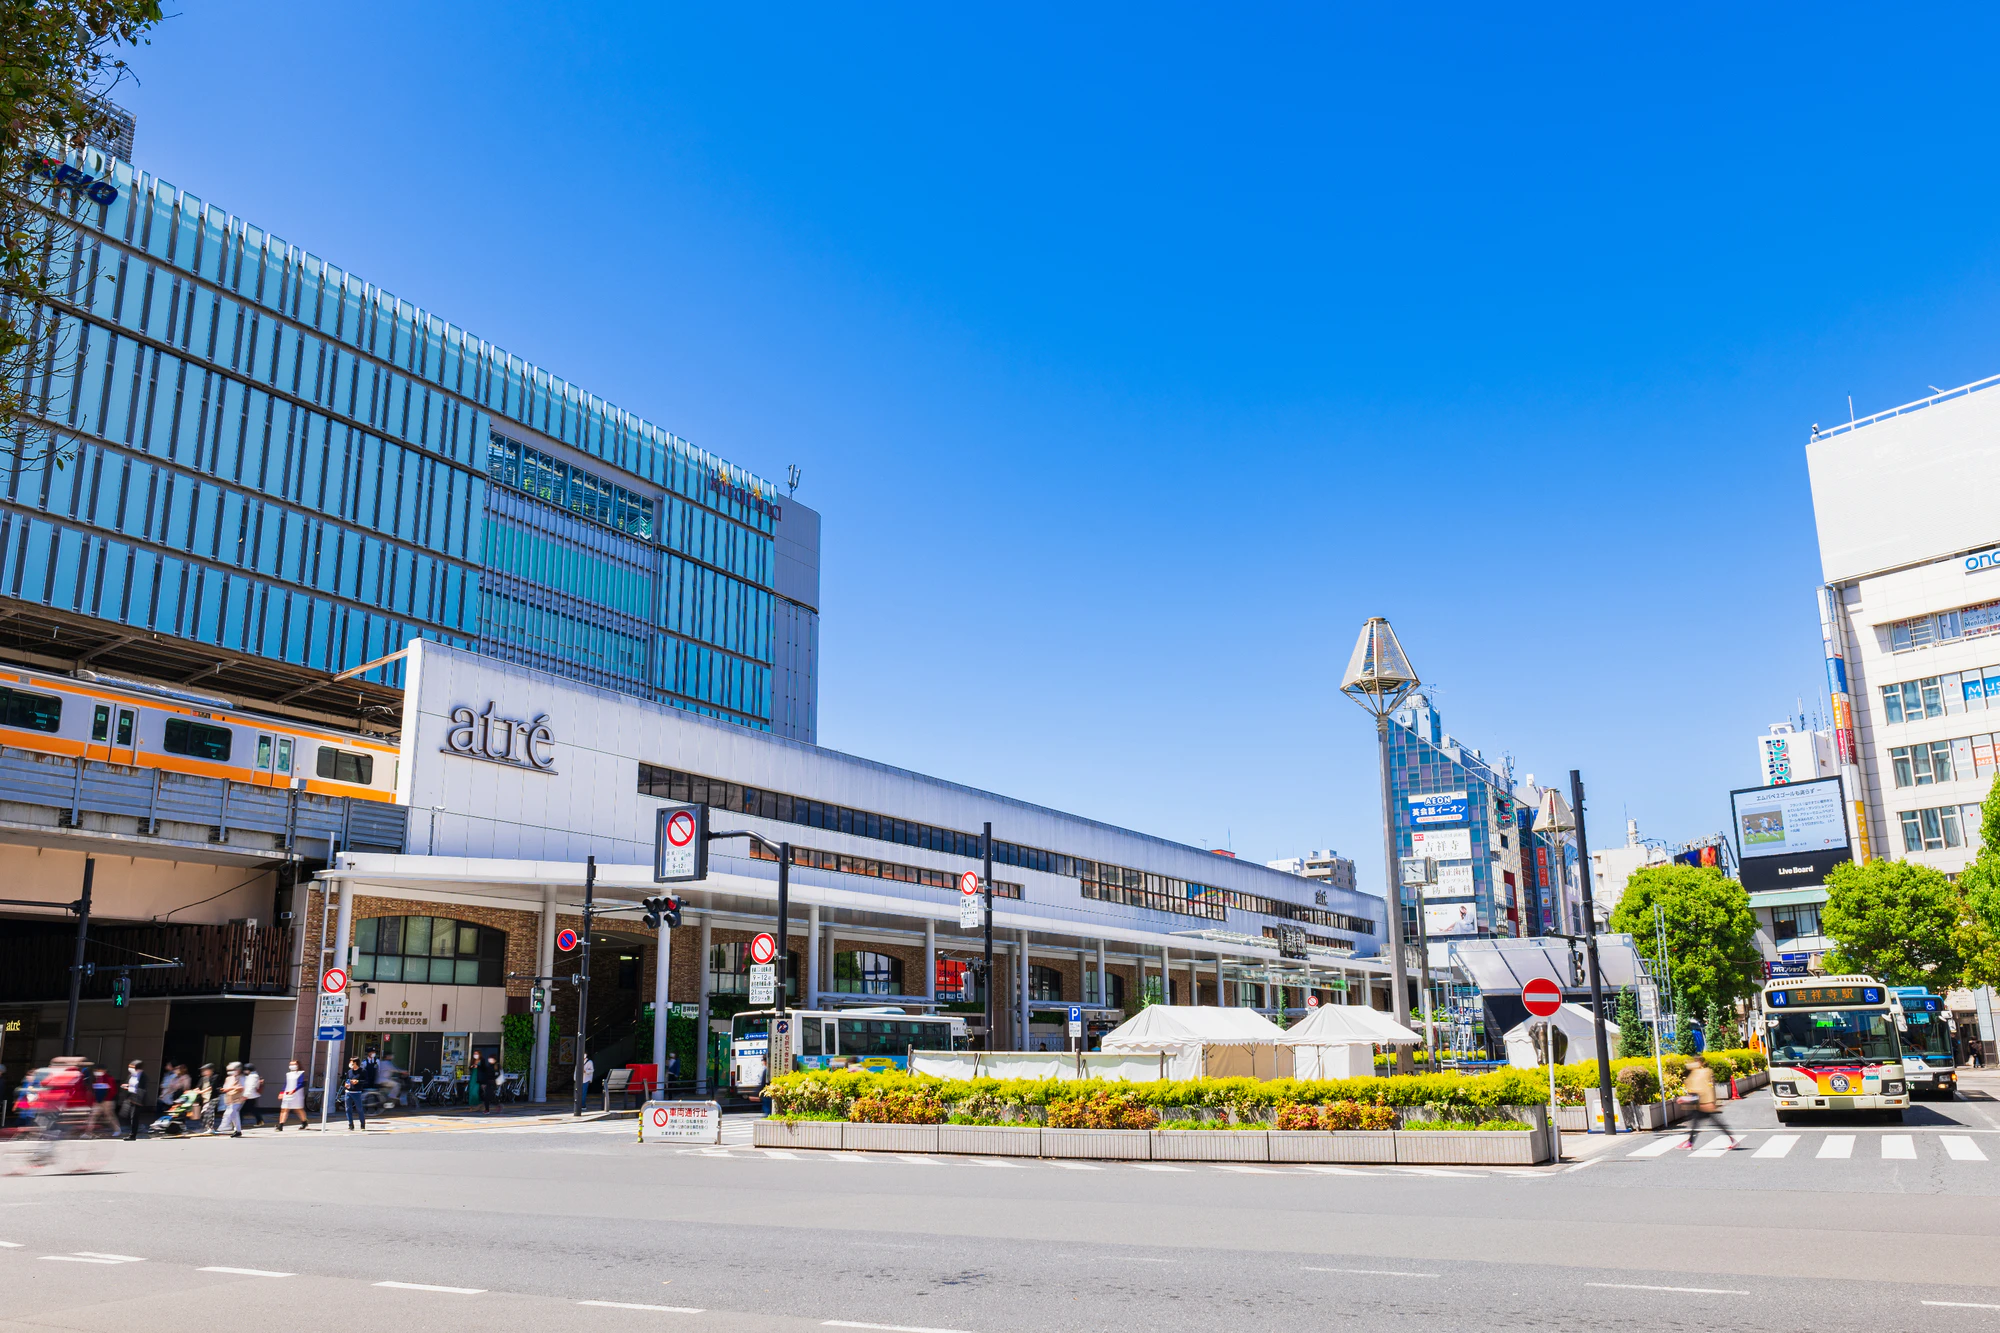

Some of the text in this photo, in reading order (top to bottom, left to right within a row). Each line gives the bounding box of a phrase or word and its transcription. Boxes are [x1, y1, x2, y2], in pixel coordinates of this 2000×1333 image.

[447, 700, 556, 769] atré
[1425, 796, 1451, 805] AEON
[1412, 805, 1466, 817] 英会話イーオン
[1778, 865, 1814, 875] Live Board
[1796, 988, 1854, 1000] 吉祥寺駅
[1071, 1008, 1079, 1020] P
[669, 1107, 708, 1118] 車両通行止
